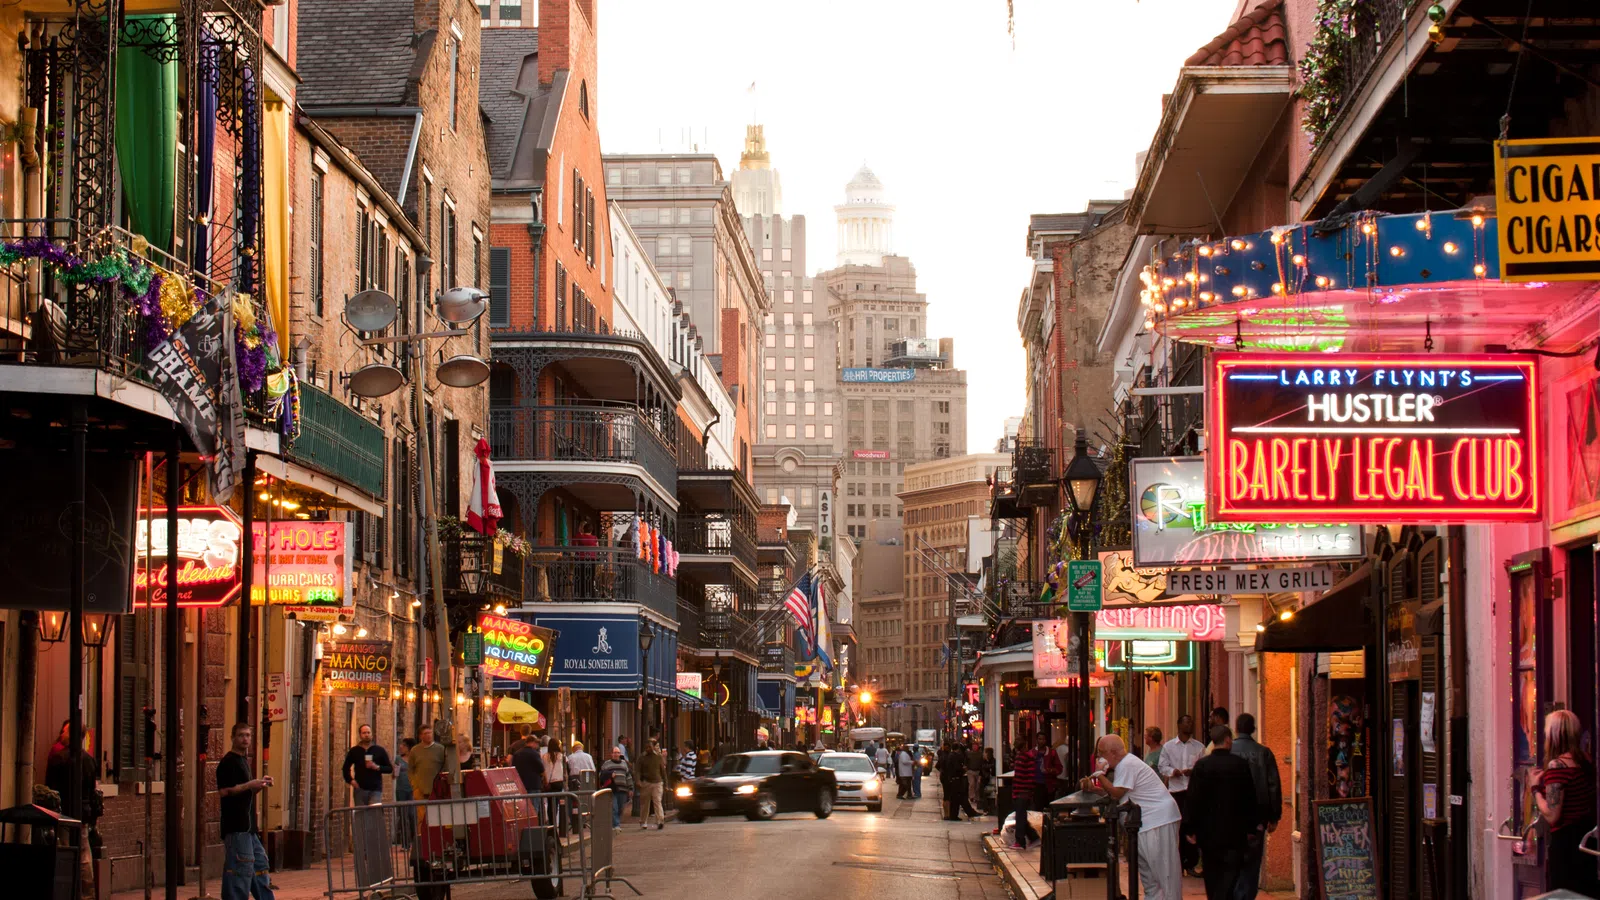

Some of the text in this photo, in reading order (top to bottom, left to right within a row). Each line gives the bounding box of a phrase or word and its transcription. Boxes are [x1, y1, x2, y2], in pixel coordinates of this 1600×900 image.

[173, 339, 207, 388] SUPER
[855, 370, 911, 381] HRI PROPERTIES
[1281, 369, 1472, 387] LARRY FLYNT'S
[1230, 437, 1524, 500] BARELY LEGAL CLUB
[281, 529, 337, 550] HOLE
[1262, 533, 1352, 551] HOUSE
[279, 554, 294, 564] RAT
[296, 554, 328, 564] ATTACK
[1170, 570, 1330, 591] FRESH MEX GRILL
[152, 588, 192, 601] Caret
[307, 589, 335, 601] BEER
[482, 616, 530, 634] MANGO
[341, 643, 376, 654] MANGO
[484, 629, 544, 654] ANGO
[330, 652, 388, 671] MANGO
[514, 664, 539, 677] BEER
[564, 659, 628, 669] ROYAL SONESTA HOTEL
[331, 670, 382, 682] DAIQUIRIS
